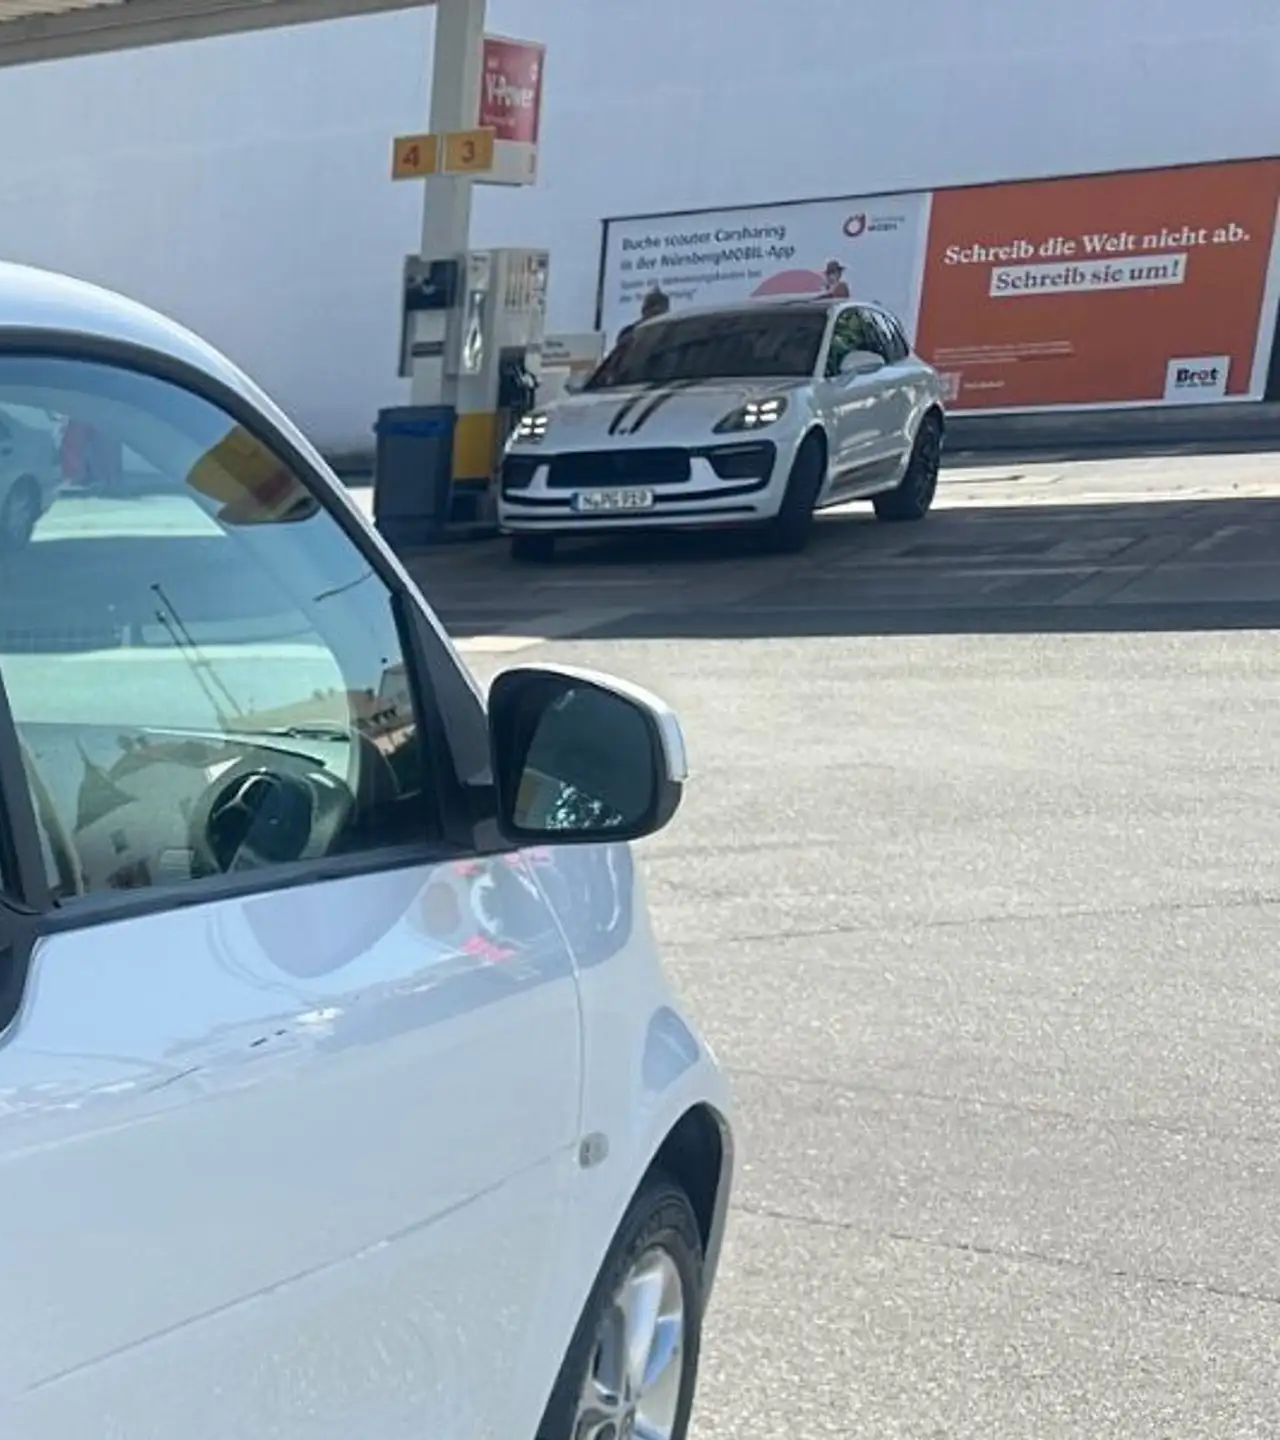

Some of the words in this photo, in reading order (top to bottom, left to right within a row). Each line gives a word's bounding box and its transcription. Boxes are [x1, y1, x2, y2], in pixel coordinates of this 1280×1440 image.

[402, 144, 420, 168] 4
[461, 140, 476, 164] 3
[715, 225, 786, 243] Carsharing
[944, 239, 1034, 265] Schreib
[1039, 239, 1076, 256] die
[1083, 232, 1137, 253] Welt
[1142, 228, 1208, 249] nicht
[1212, 223, 1251, 243] ab.
[636, 256, 657, 271] der
[995, 265, 1085, 291] Schreib
[1091, 262, 1124, 283] sie
[1129, 260, 1180, 282] um!
